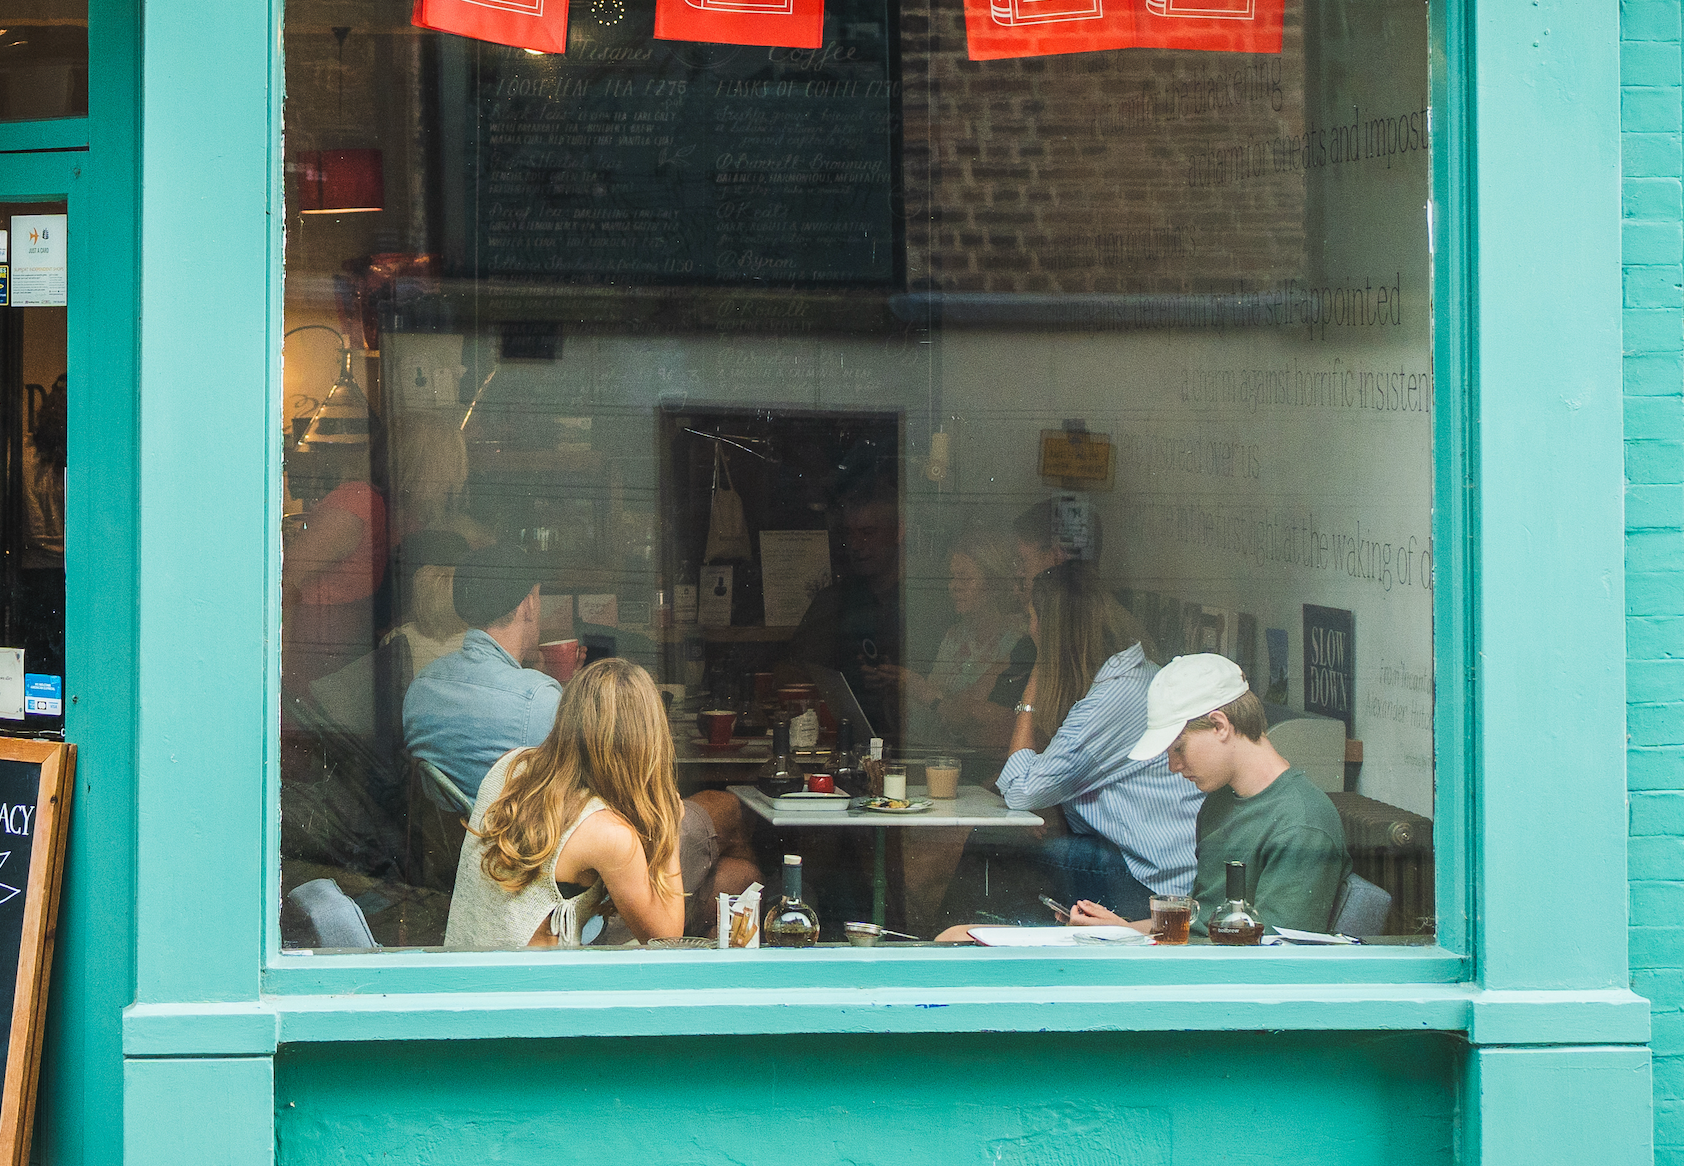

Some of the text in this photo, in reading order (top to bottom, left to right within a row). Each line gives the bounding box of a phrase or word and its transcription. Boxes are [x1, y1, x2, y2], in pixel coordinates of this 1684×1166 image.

[576, 42, 652, 61] Tisanes
[768, 40, 862, 71] Coffee
[716, 79, 859, 97] FLASKS OF COFFEE
[1330, 107, 1360, 164] and
[1364, 97, 1430, 169] impost
[1265, 272, 1401, 341] self-appointed
[1293, 357, 1355, 409] horrific
[1359, 359, 1429, 414] insisten
[1302, 513, 1329, 569] the
[1332, 520, 1393, 592] waking
[1396, 534, 1418, 586] of
[1311, 626, 1346, 669] SLOW
[1311, 666, 1347, 712] DOWN
